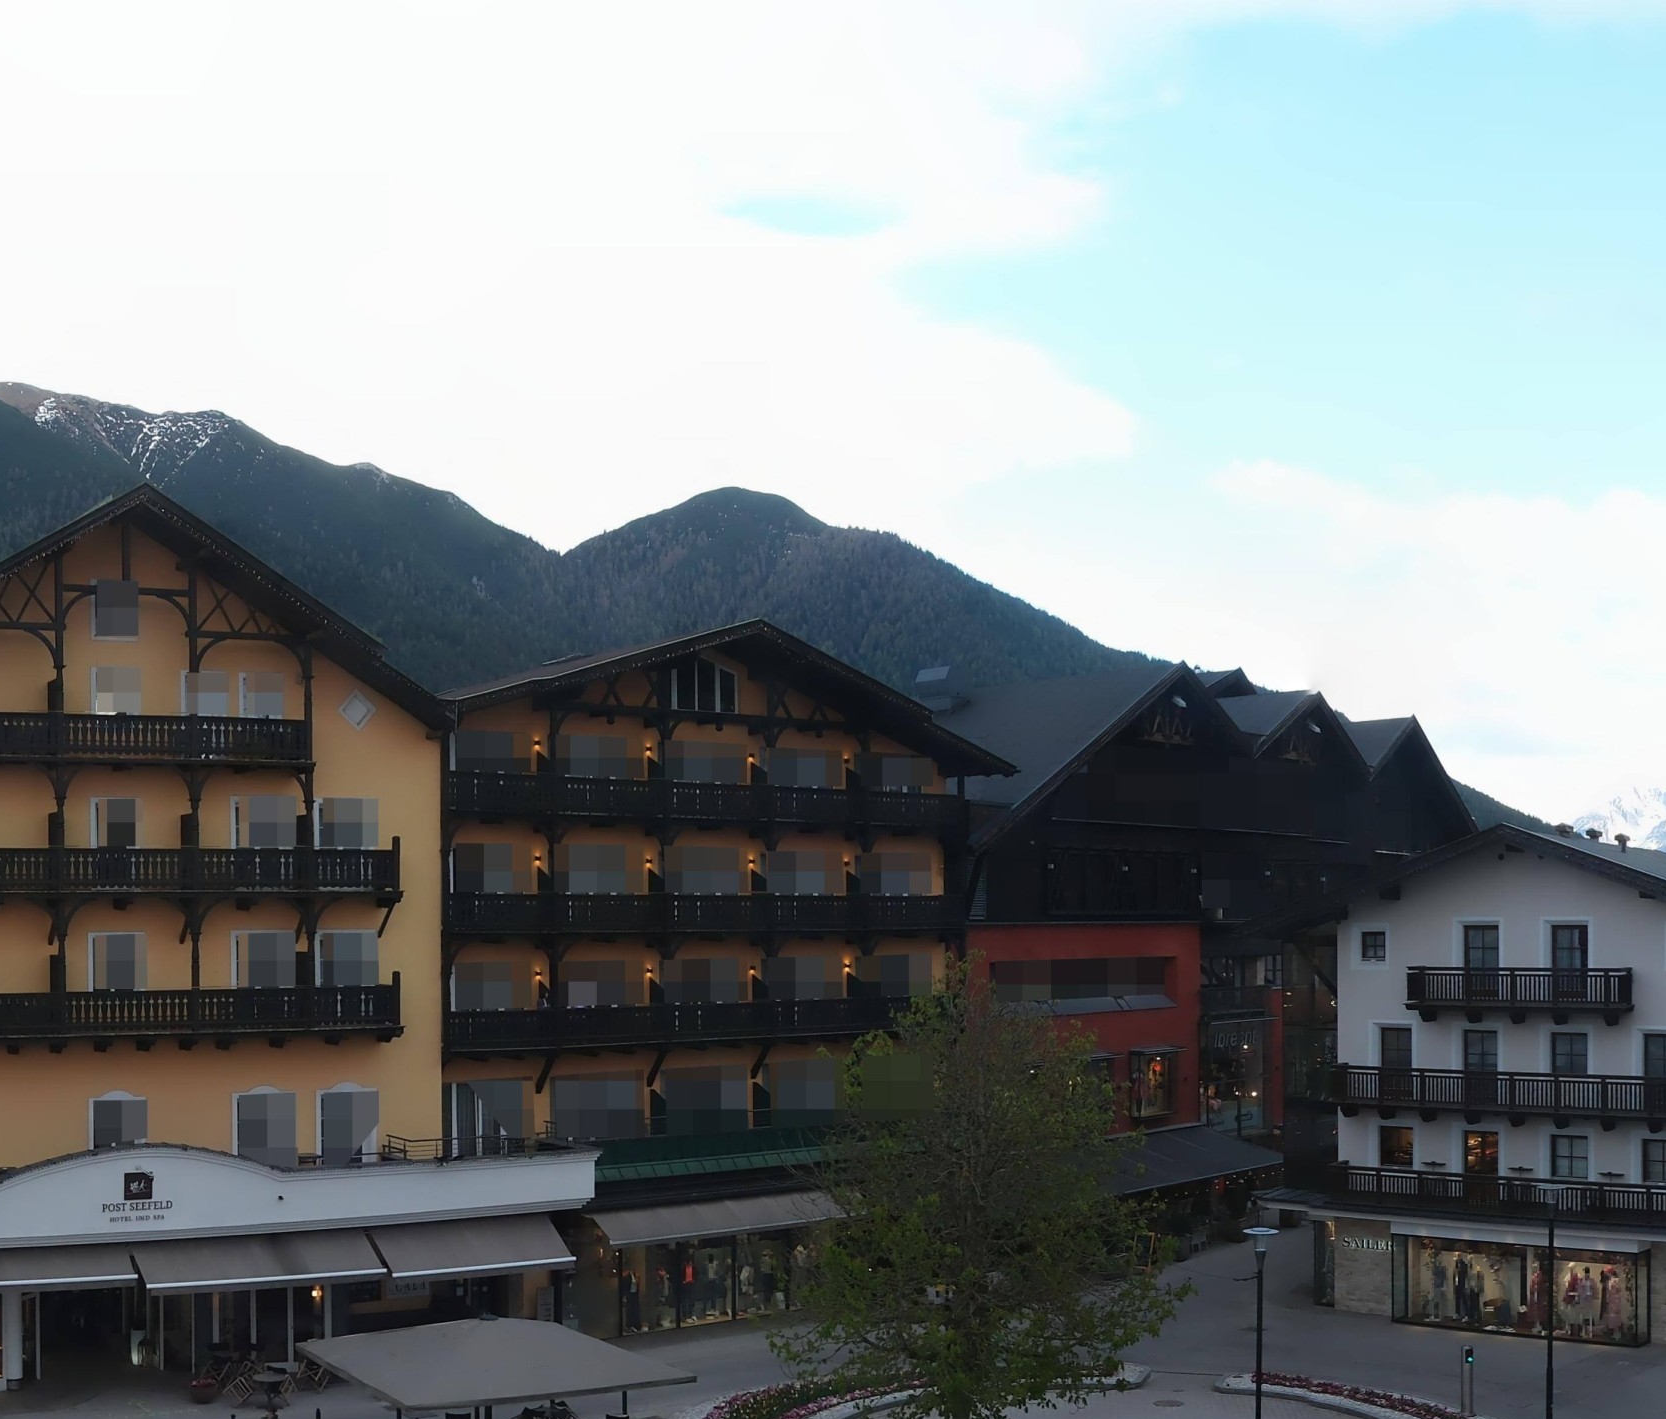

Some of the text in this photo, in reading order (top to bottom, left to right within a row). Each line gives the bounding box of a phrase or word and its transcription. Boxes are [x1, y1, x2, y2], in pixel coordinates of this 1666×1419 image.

[102, 1200, 173, 1212] POST SEEFELD
[1342, 1236, 1396, 1252] SAILER
